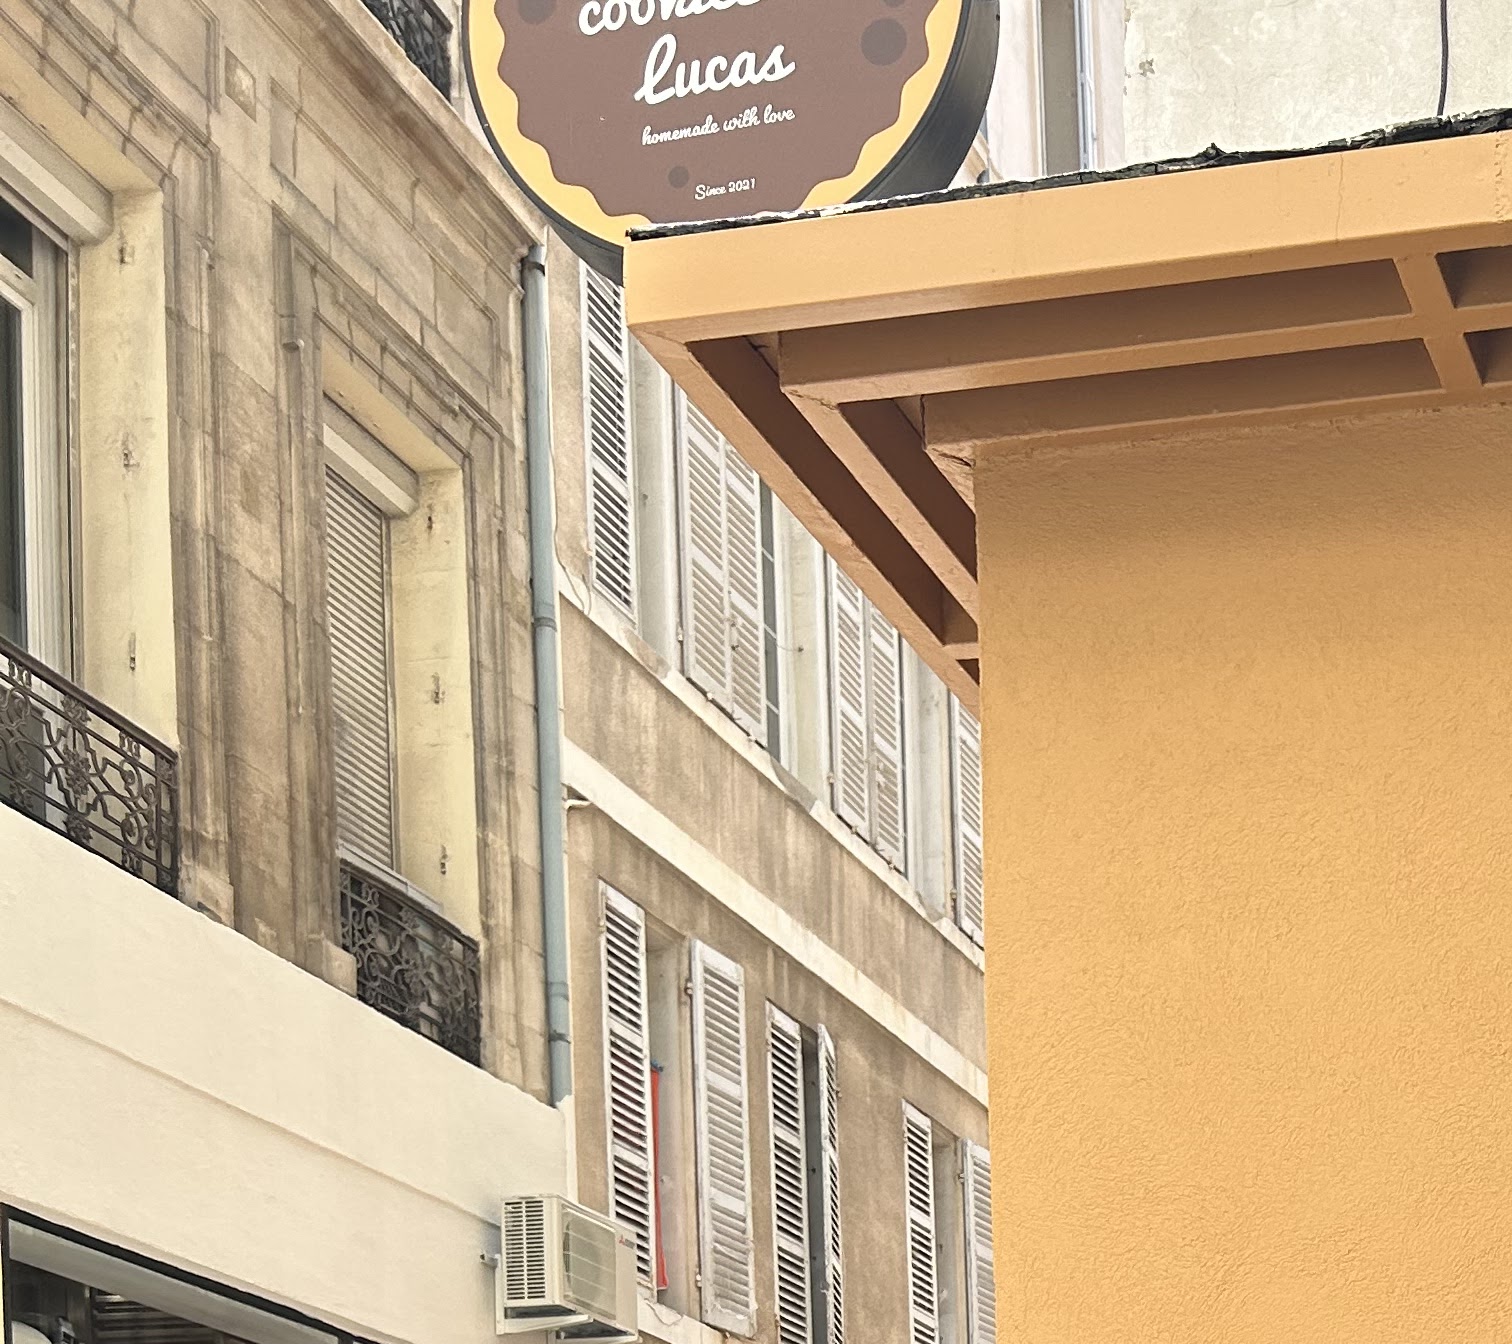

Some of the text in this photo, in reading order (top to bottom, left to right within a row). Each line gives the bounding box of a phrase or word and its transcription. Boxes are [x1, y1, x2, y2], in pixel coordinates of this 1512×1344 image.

[634, 33, 796, 105] Lucas
[641, 103, 796, 146] homemade with love
[694, 177, 756, 200] Since 2021
